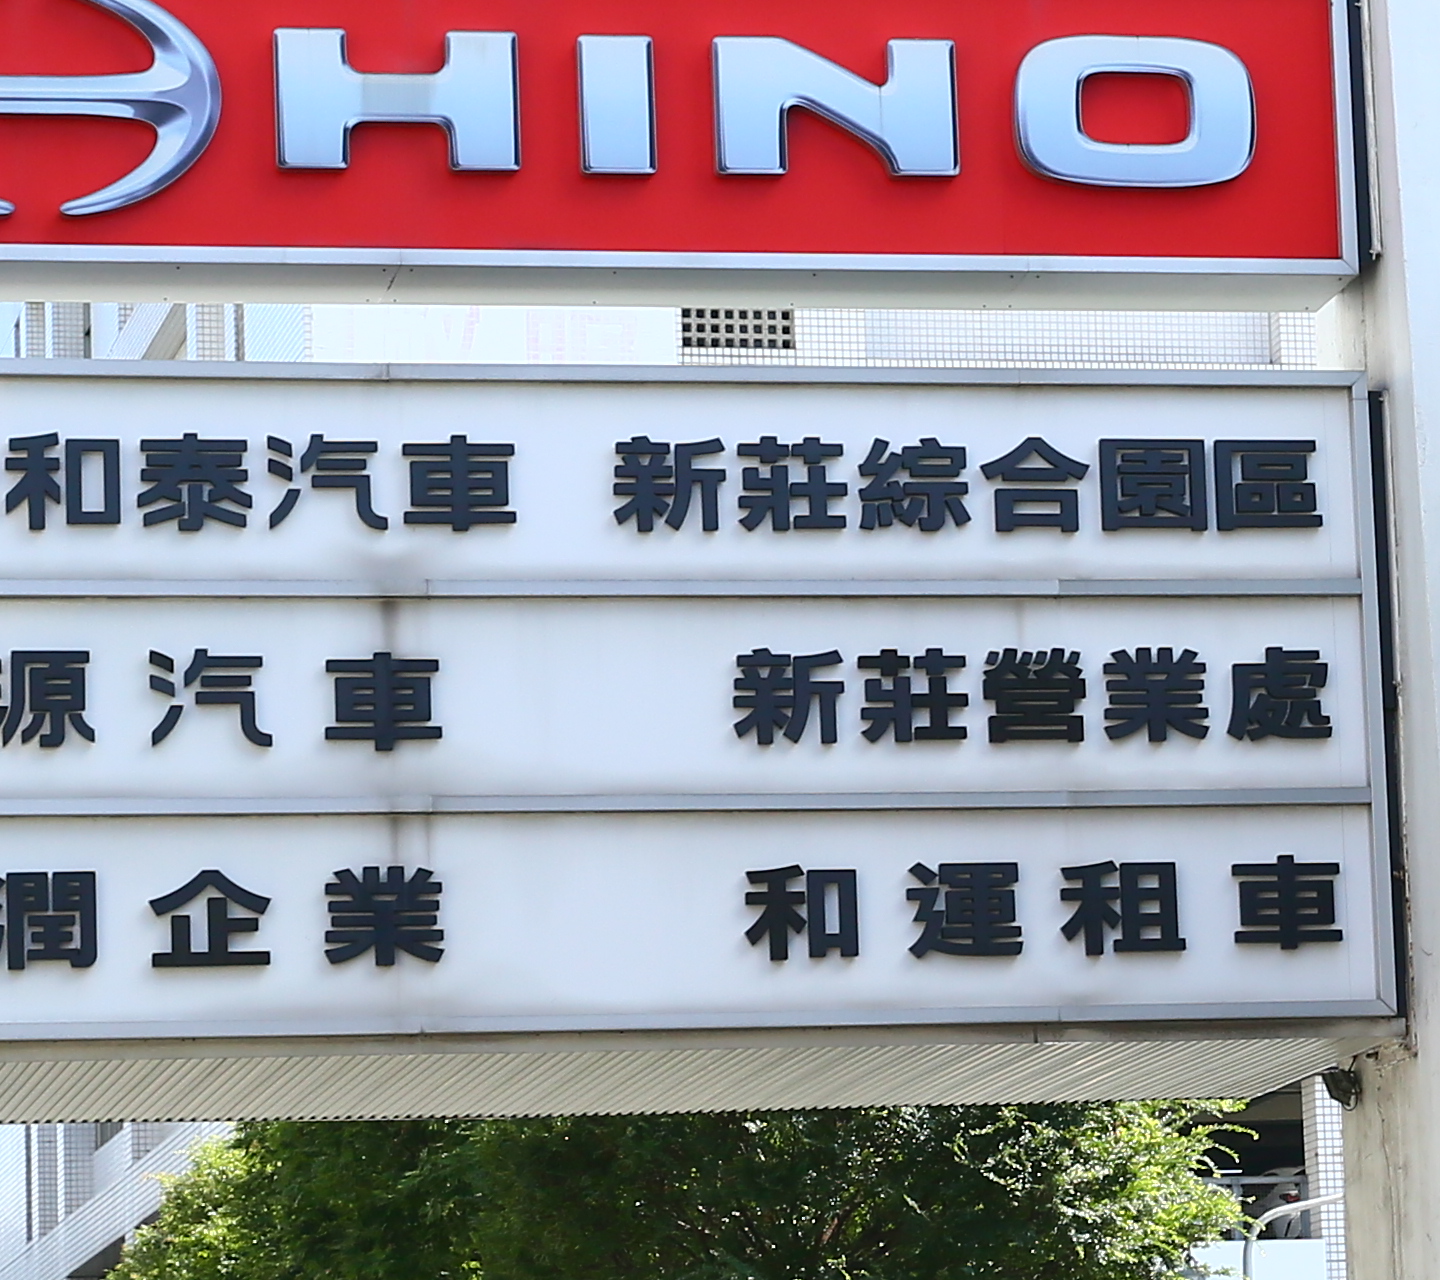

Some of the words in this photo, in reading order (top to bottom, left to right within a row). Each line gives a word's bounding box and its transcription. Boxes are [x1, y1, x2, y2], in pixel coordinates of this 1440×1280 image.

[273, 25, 1257, 189] HINO
[4, 431, 517, 533] 和泰汽車
[613, 434, 1323, 534] 新莊綜合園區
[732, 645, 1333, 746] 新莊營業處
[743, 853, 1344, 961] 和運租車
